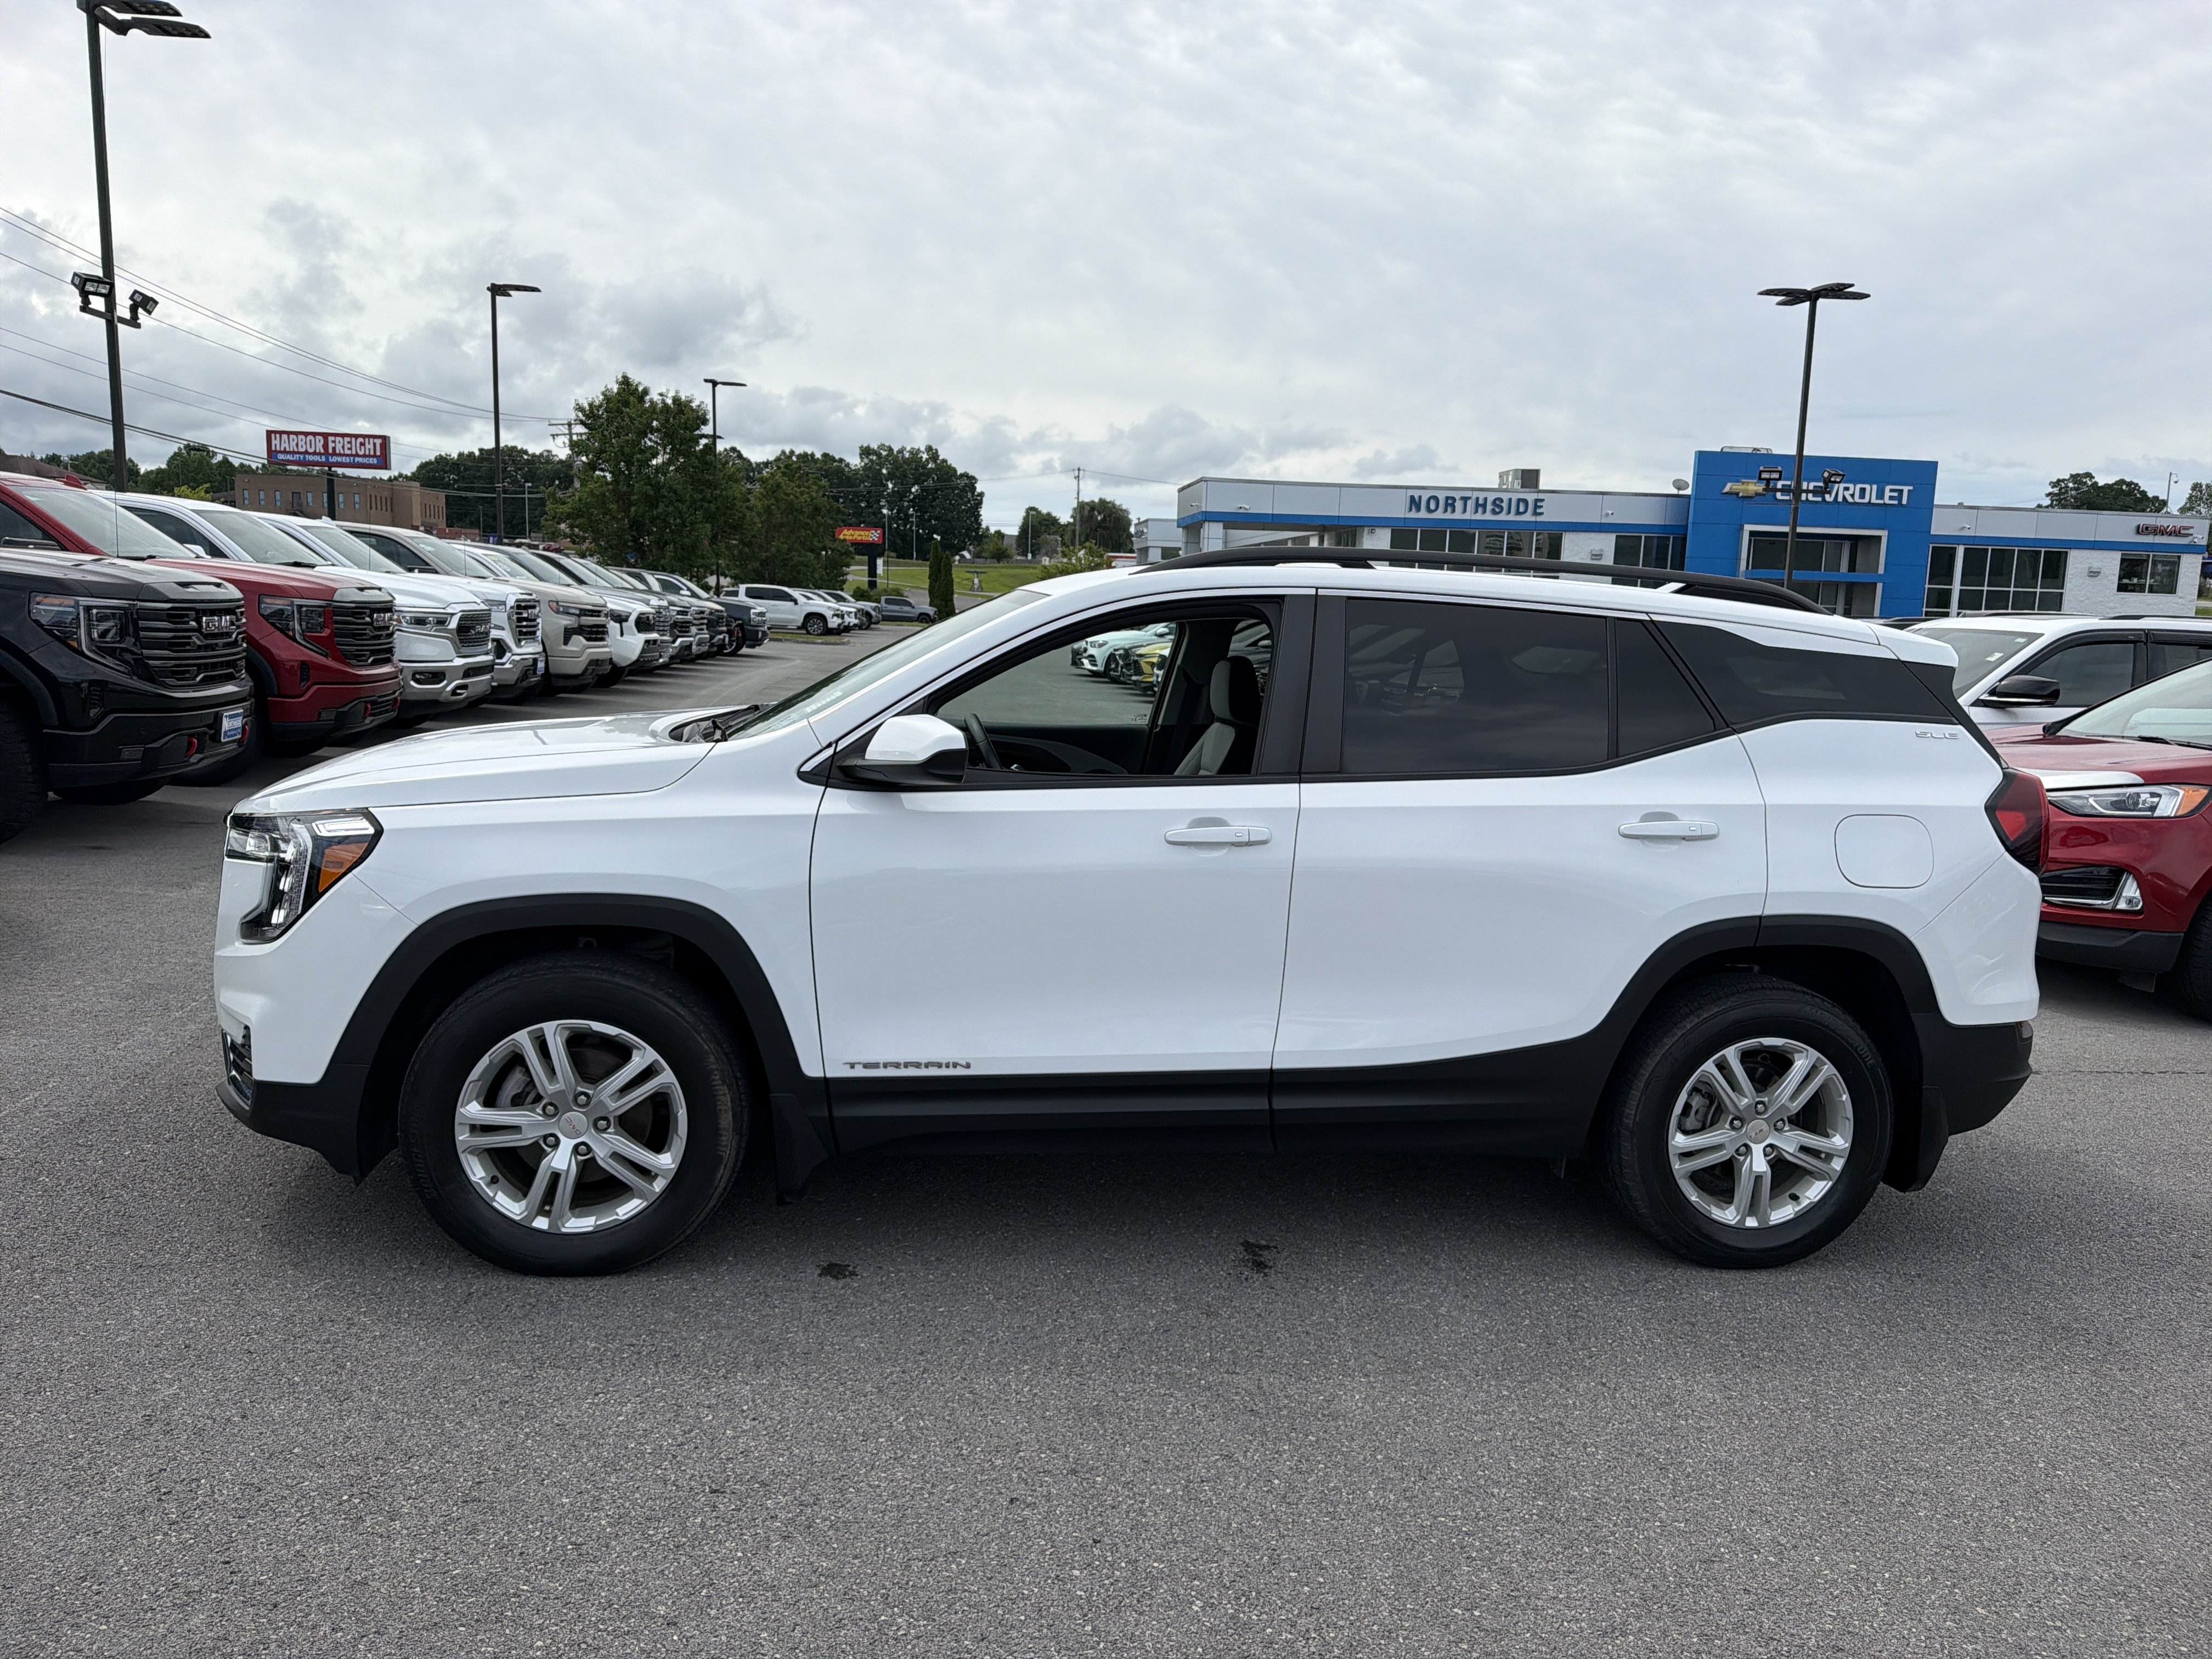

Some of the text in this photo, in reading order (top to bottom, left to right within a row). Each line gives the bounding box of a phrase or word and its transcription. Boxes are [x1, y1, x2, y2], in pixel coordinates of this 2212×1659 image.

[271, 433, 382, 456] HARBOR FREIGHT
[1407, 495, 1546, 516] NORTHSIDE
[2138, 523, 2194, 537] GMC
[1915, 730, 1959, 740] SLE
[843, 1061, 971, 1069] TERRAIN
